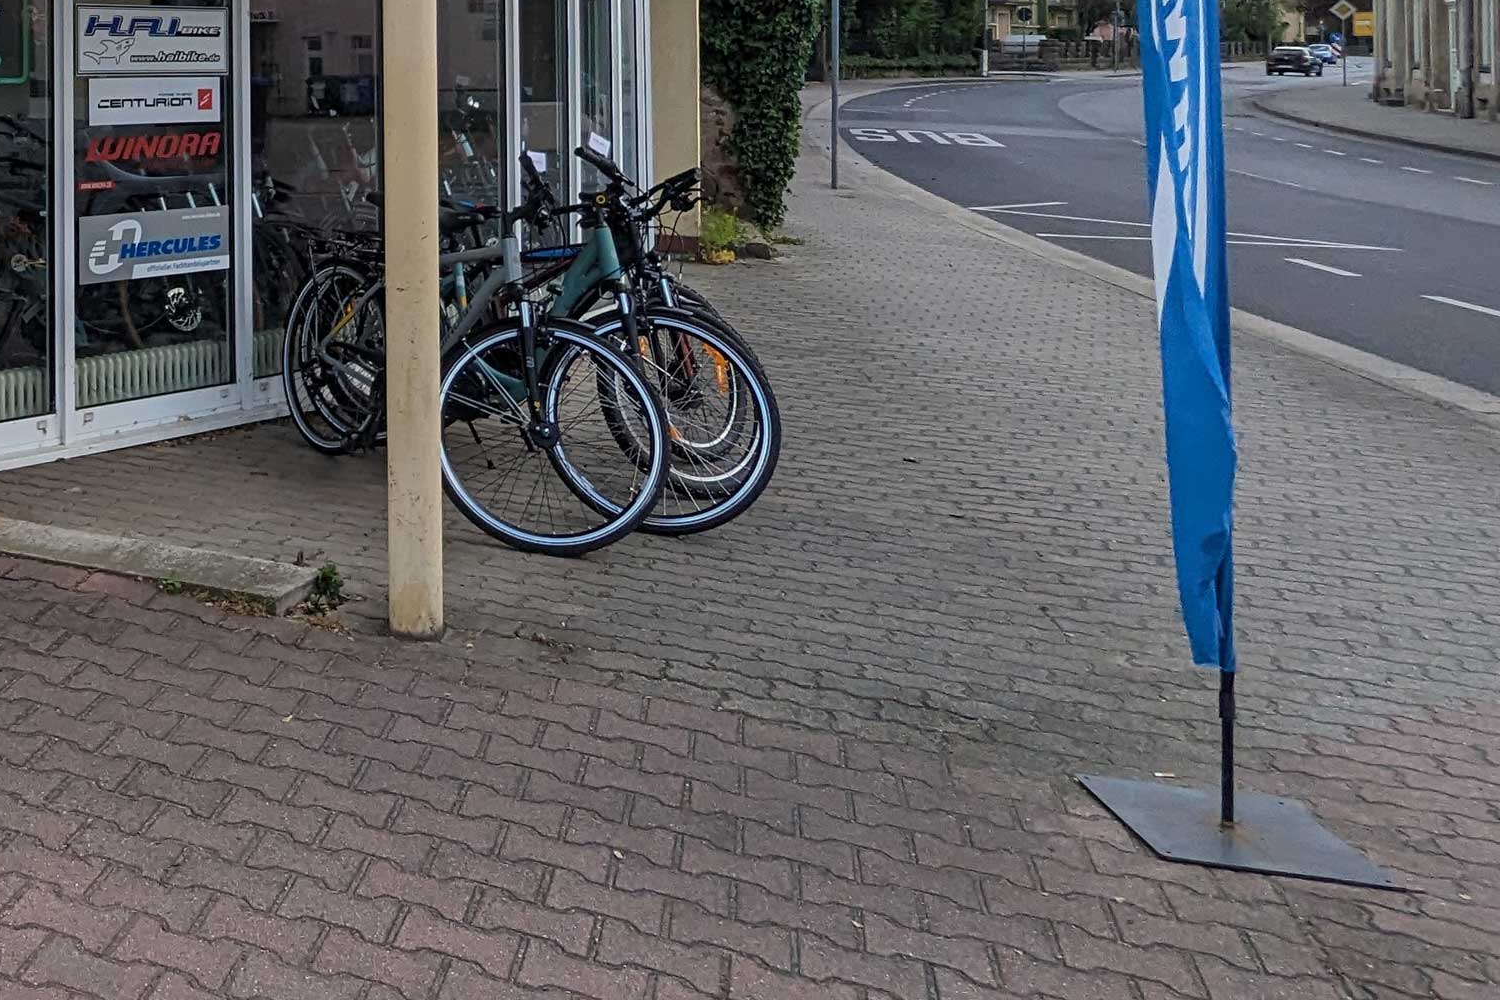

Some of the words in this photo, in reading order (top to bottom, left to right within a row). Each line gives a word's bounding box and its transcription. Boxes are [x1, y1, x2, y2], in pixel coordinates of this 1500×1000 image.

[130, 50, 221, 64] www.haibike.de
[97, 97, 193, 109] CENTURION
[85, 131, 221, 163] WINORA
[849, 127, 1007, 148] BUS
[120, 234, 222, 260] HERCULES
